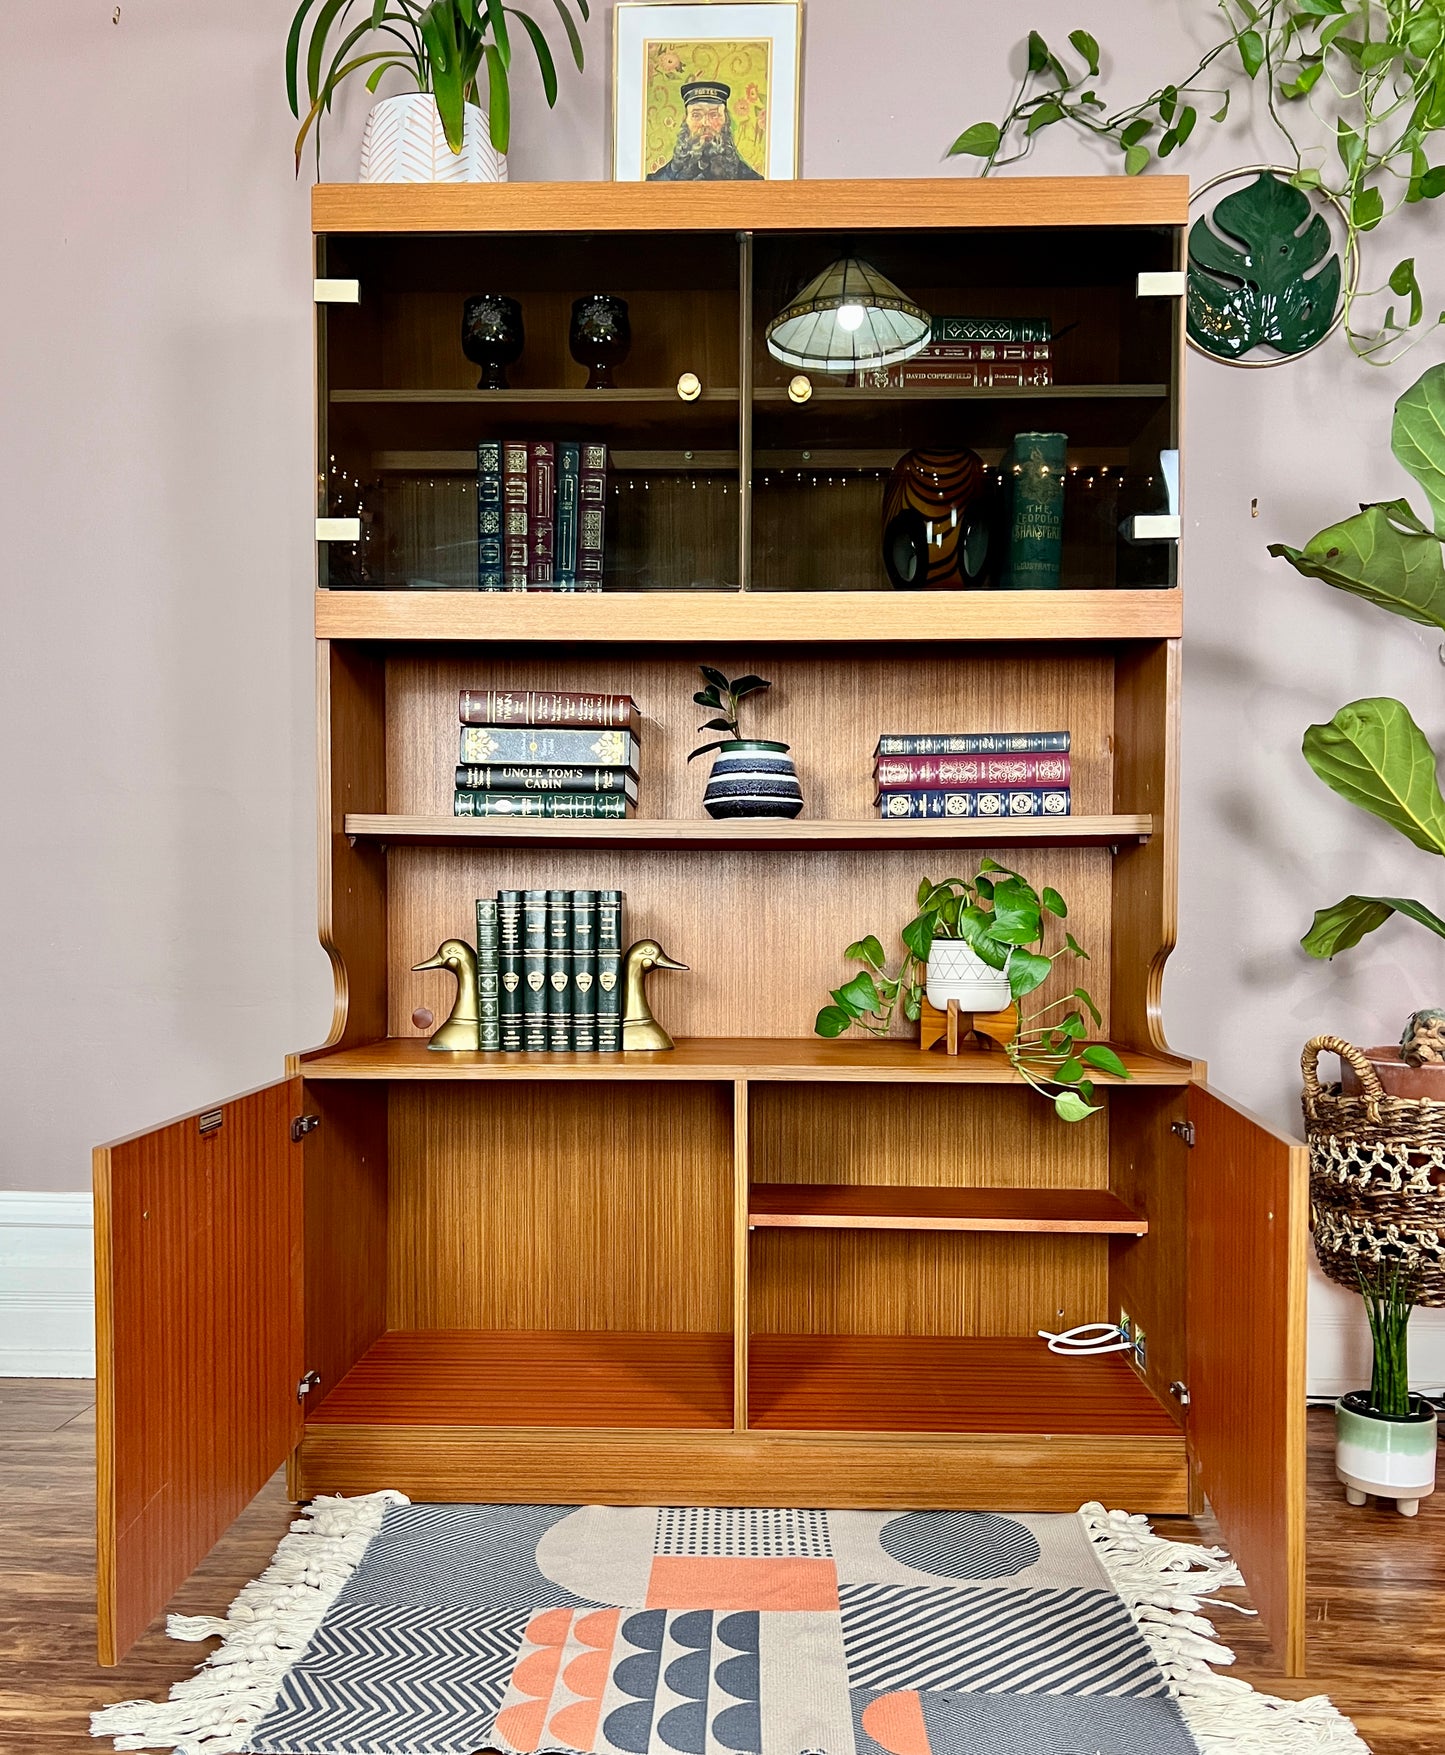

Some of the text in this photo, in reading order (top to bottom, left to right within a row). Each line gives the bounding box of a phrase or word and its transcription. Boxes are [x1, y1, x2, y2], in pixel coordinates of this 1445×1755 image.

[1026, 504, 1053, 514] THE
[1014, 562, 1059, 572] ILLUSTRATE
[503, 693, 513, 720] TWAIN
[502, 767, 584, 779] UNCLE TOM'S
[525, 778, 562, 789] CABIN
